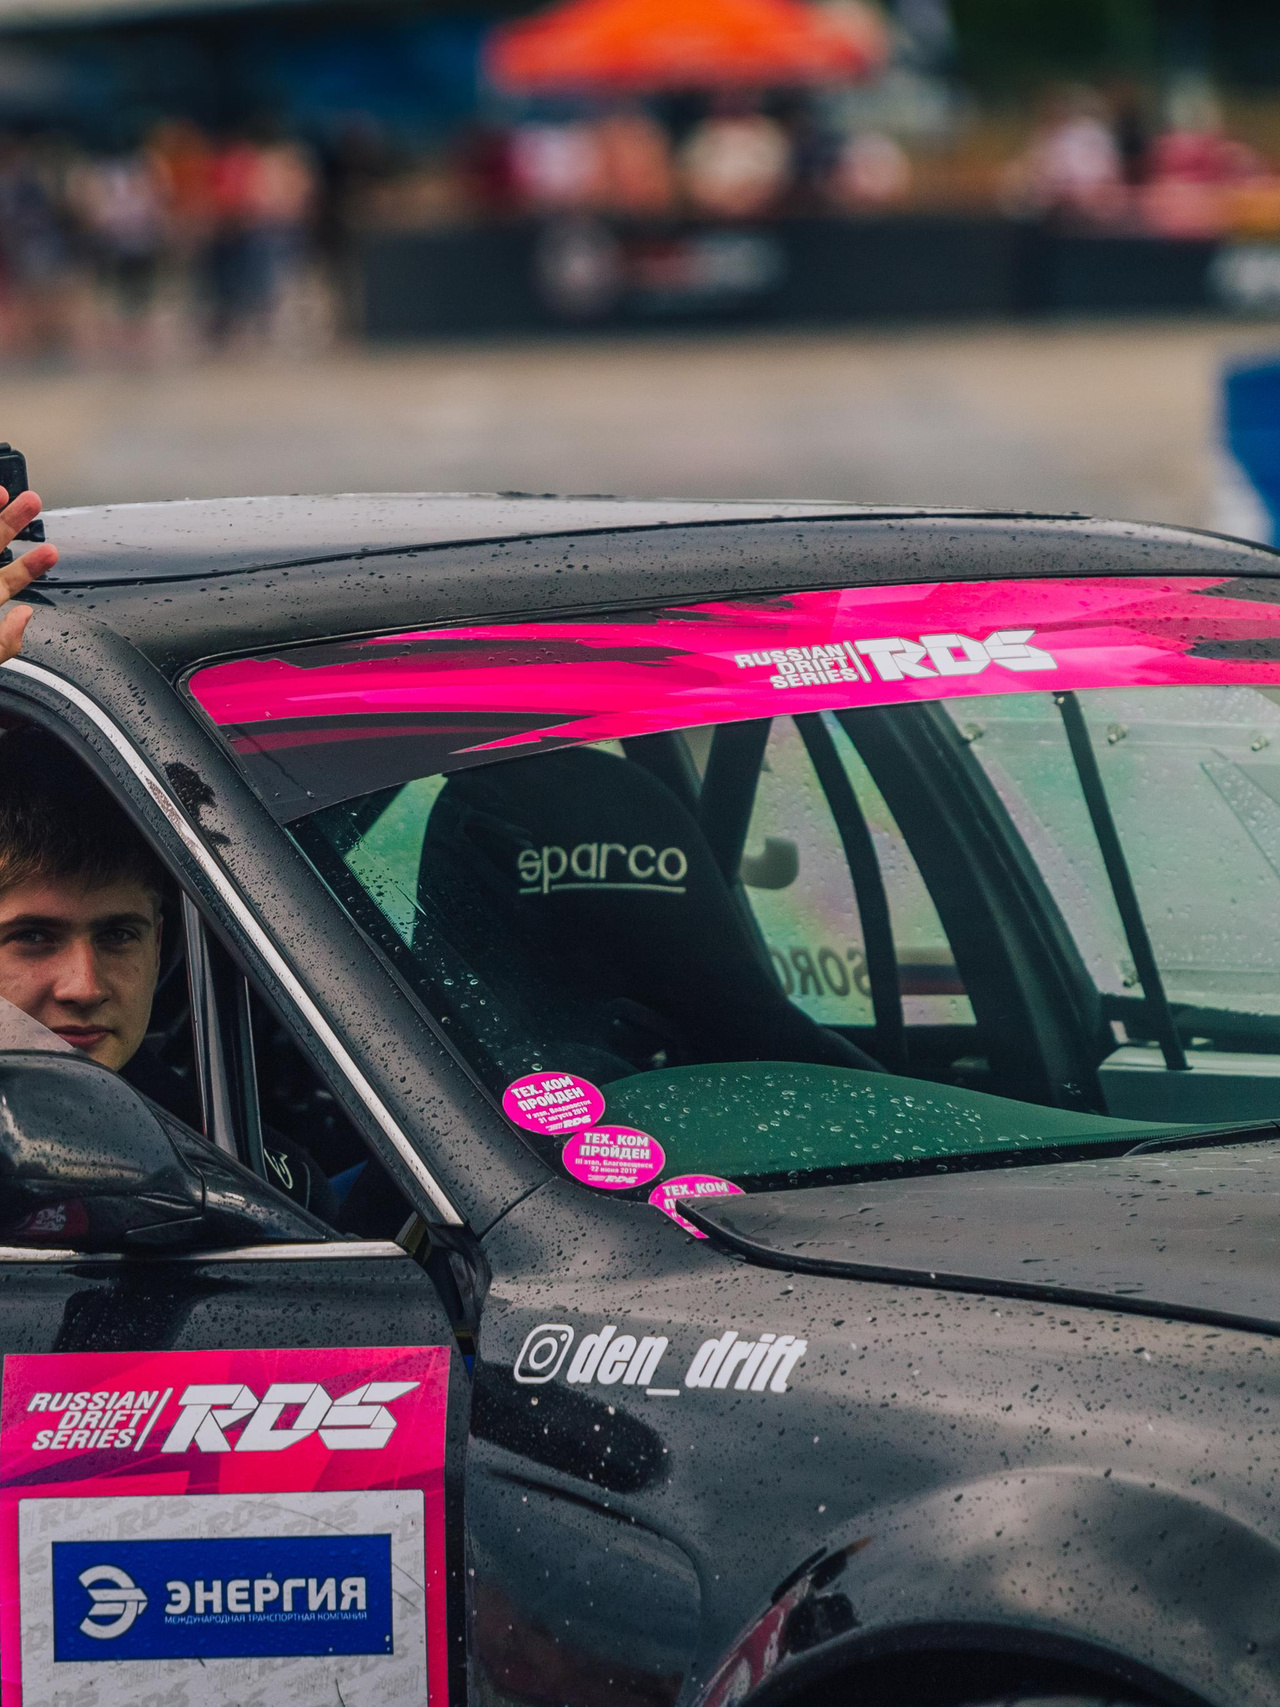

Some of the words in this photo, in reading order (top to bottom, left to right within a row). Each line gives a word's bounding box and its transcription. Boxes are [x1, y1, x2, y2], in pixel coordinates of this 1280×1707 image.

[734, 644, 844, 668] RUSSIAN
[776, 655, 848, 676] DRIFT
[855, 629, 1058, 682] RDS
[769, 668, 860, 689] SERIES
[518, 842, 687, 894] sparco
[511, 1084, 543, 1099] ТЕХ.
[540, 1075, 575, 1092] КОМ
[517, 1086, 585, 1112] ПРОЙДЕН
[572, 1106, 589, 1116] 2019
[584, 1132, 614, 1145] ТЕХ.
[616, 1134, 649, 1147] КОМ
[580, 1145, 651, 1160] ПРОЙДЕН
[662, 1185, 694, 1197] ТЕХ.
[694, 1182, 729, 1196] КОМ
[27, 1390, 159, 1412] RUSSIAN
[60, 1409, 149, 1430] DRIFT
[161, 1381, 421, 1453] RDS
[31, 1428, 136, 1451] SERIES
[165, 1577, 367, 1614] ЭНЕРГИЯ
[164, 1613, 246, 1625] МЕЖДУНАРОДНАЯ
[248, 1612, 316, 1623] ТРАНСПОРТНАЯ
[317, 1611, 368, 1621] КОМПАНИЯ
